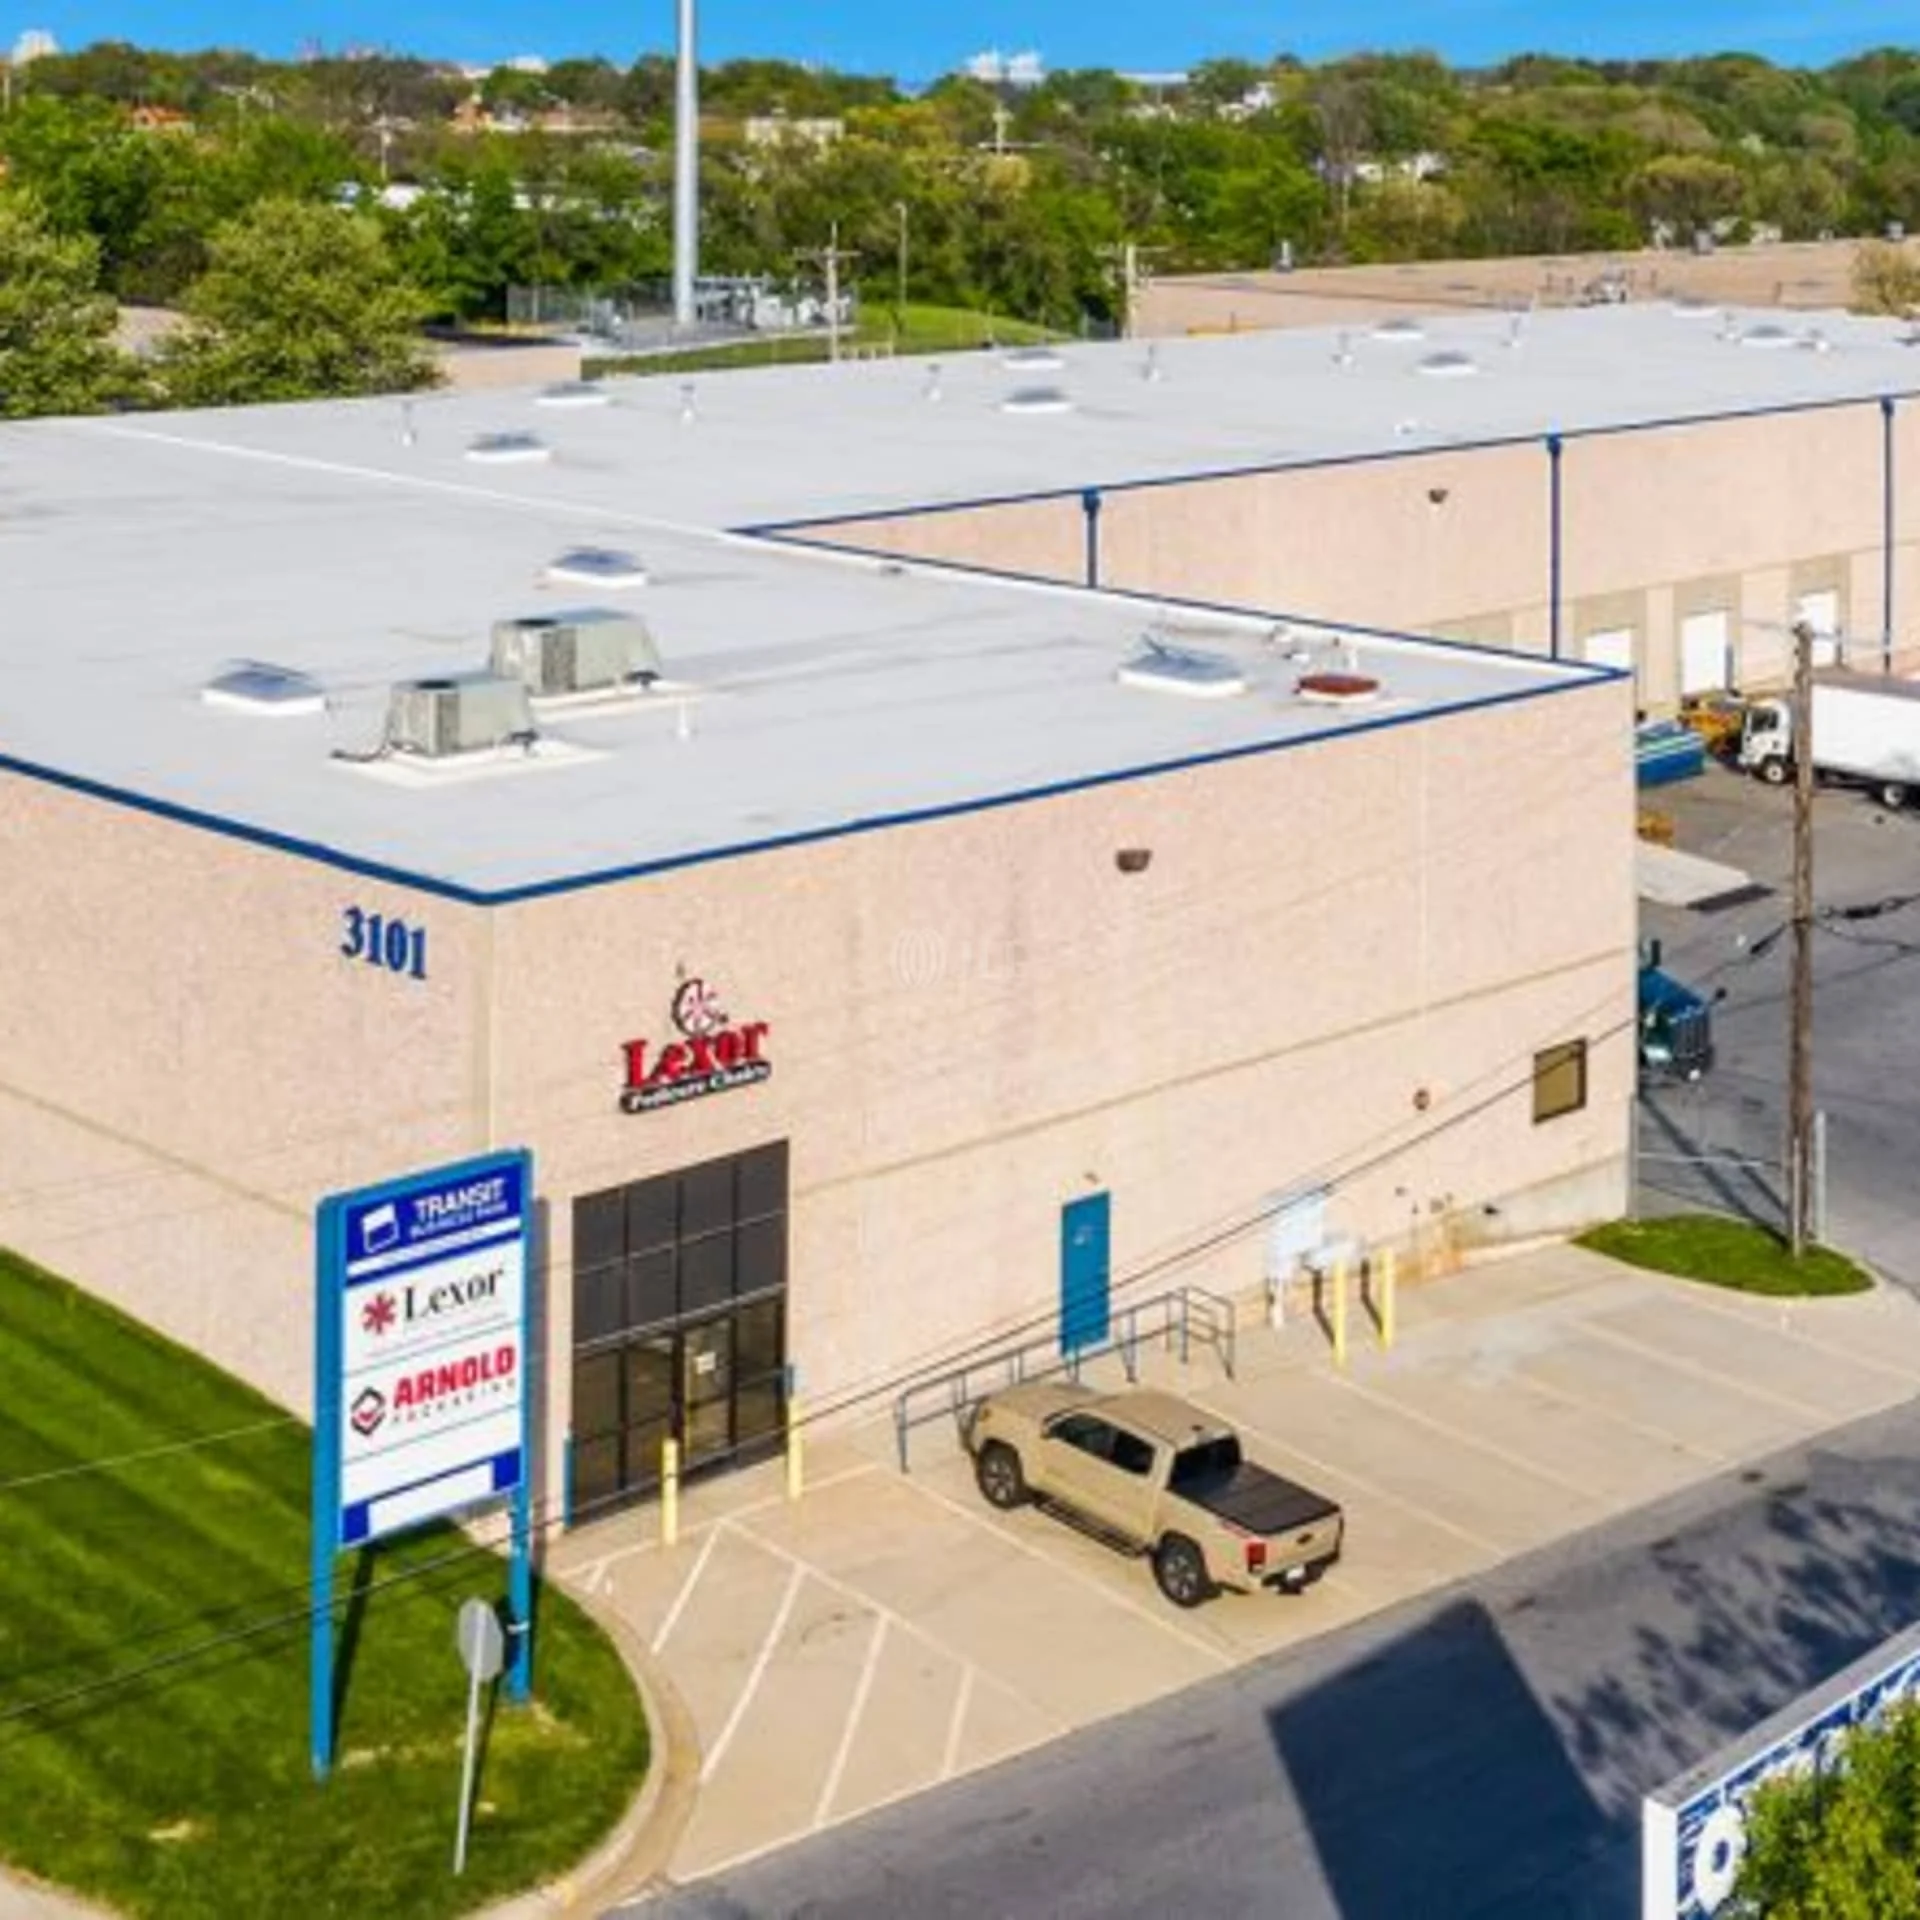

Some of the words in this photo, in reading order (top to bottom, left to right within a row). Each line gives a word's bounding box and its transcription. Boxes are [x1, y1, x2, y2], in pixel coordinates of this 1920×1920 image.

[340, 906, 426, 980] 3101
[621, 1022, 769, 1089] Lexor
[414, 1177, 505, 1221] TRANSIT
[404, 1268, 504, 1321] Lexor
[393, 1345, 516, 1409] ARNOLD
